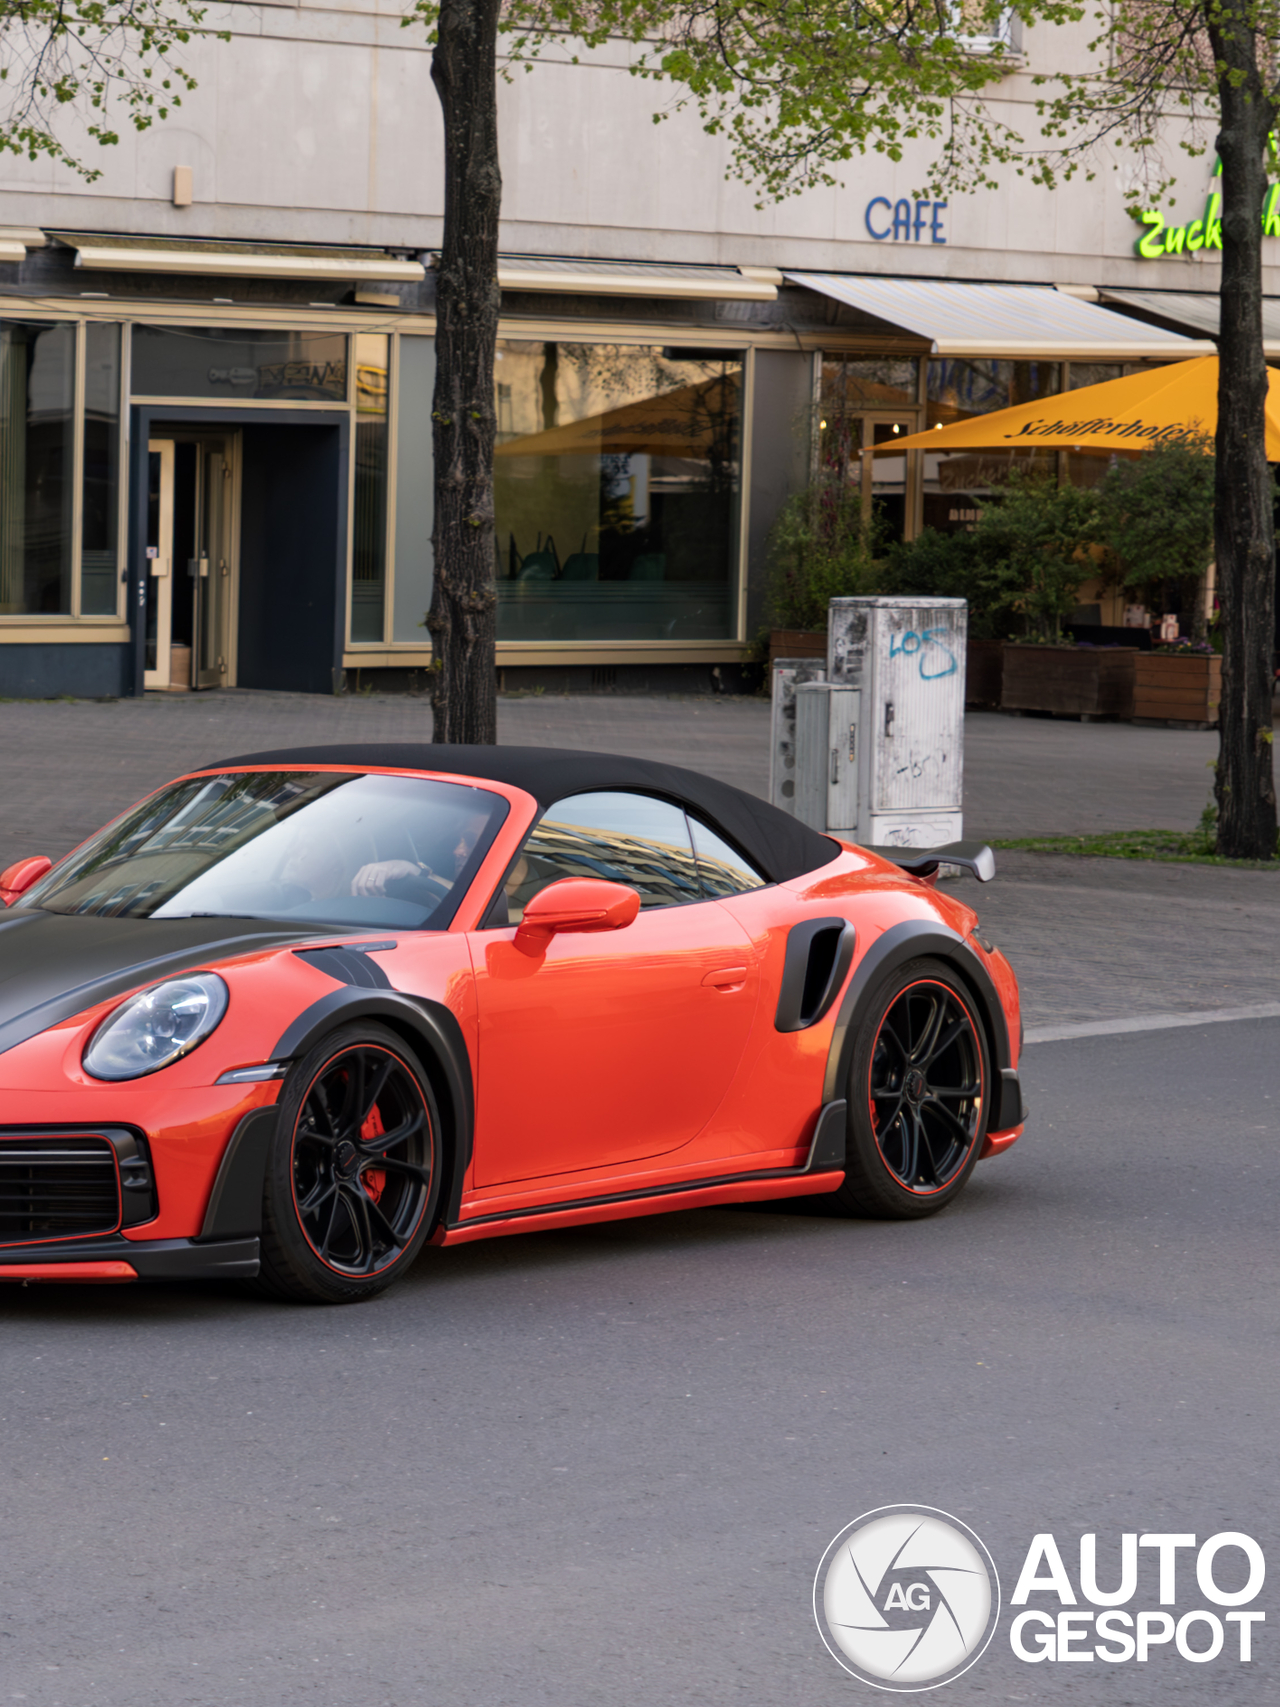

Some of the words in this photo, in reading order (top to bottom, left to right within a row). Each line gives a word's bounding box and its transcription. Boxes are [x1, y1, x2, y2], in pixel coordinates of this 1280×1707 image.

[865, 196, 948, 244] CAFE
[1135, 183, 1280, 258] Zuckh
[1004, 418, 1199, 441] Schöfferhofer
